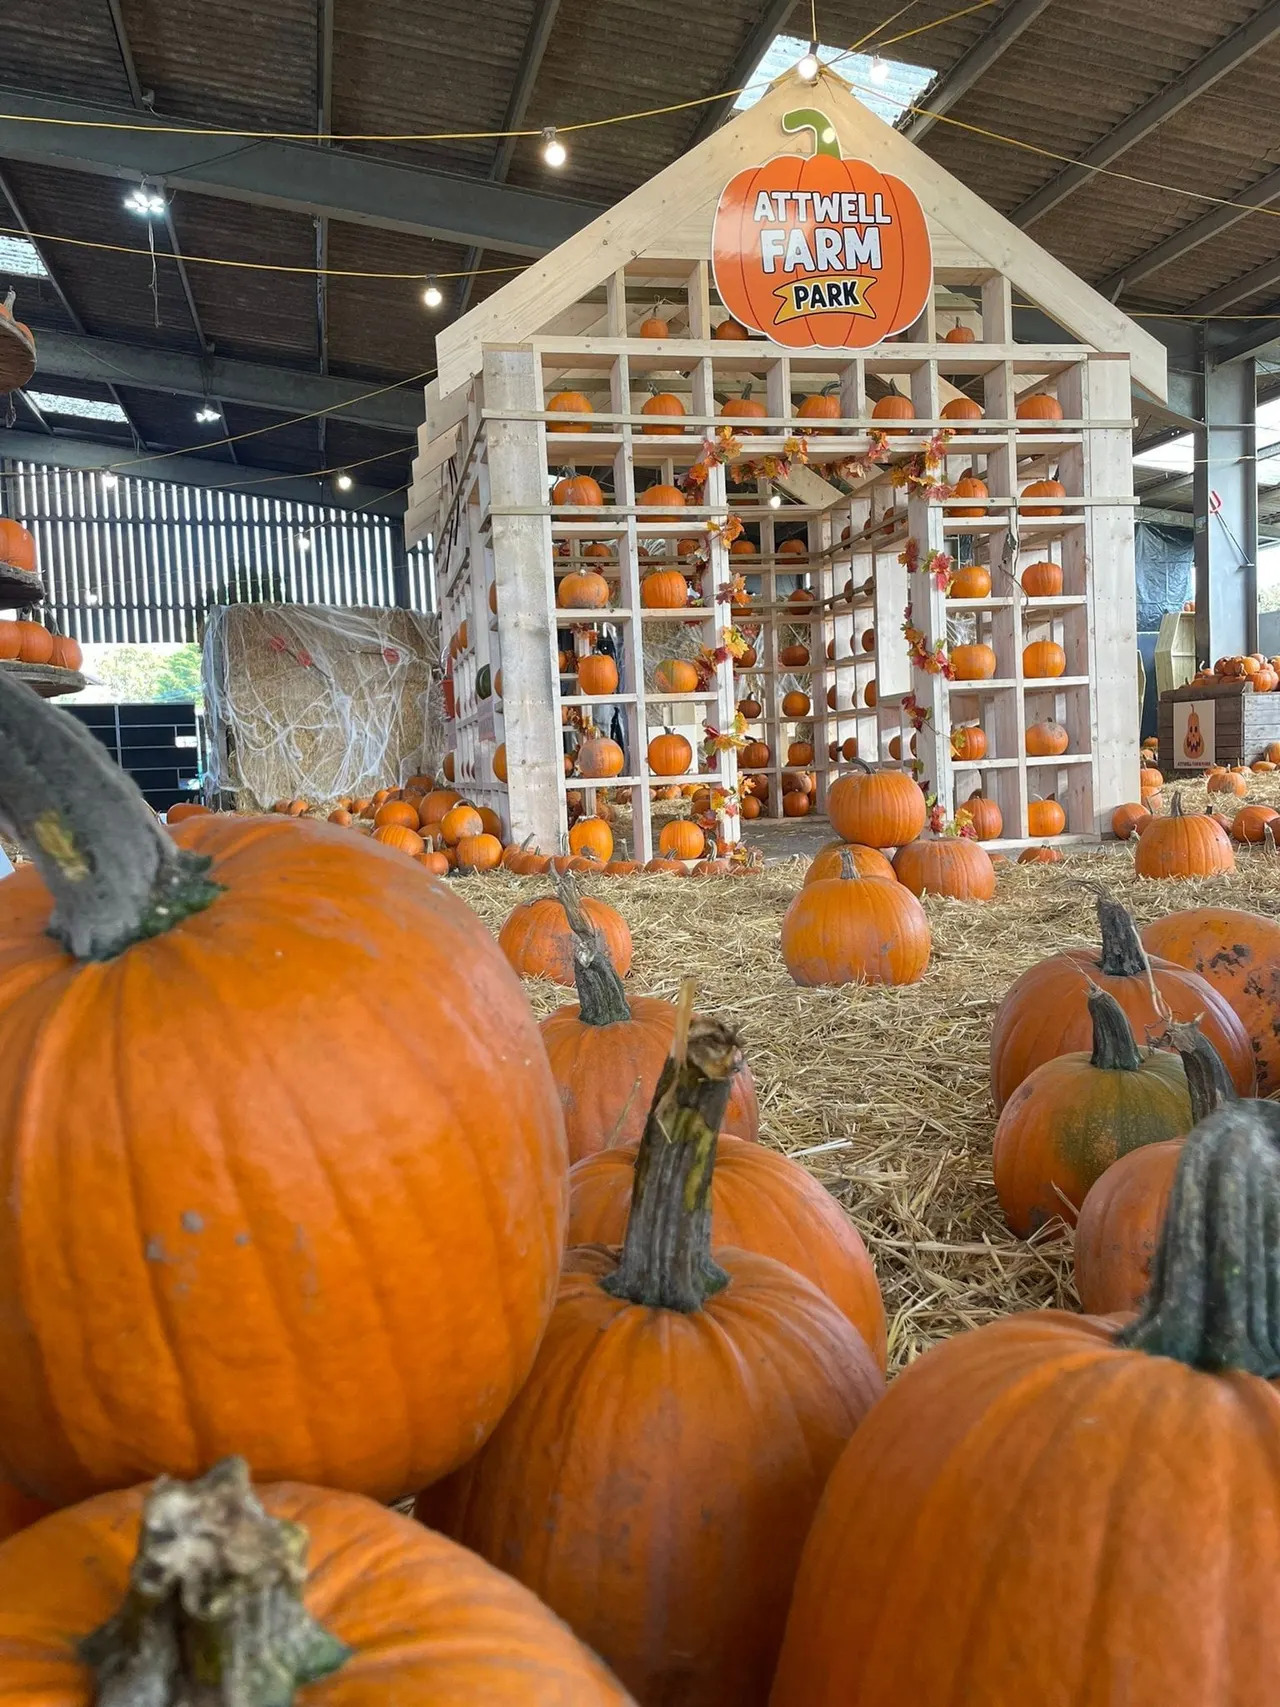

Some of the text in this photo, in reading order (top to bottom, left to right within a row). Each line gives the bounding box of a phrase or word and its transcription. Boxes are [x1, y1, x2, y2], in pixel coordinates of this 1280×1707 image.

[753, 191, 891, 224] ATTWELL
[761, 227, 882, 273] FARM
[794, 281, 859, 309] PARK
